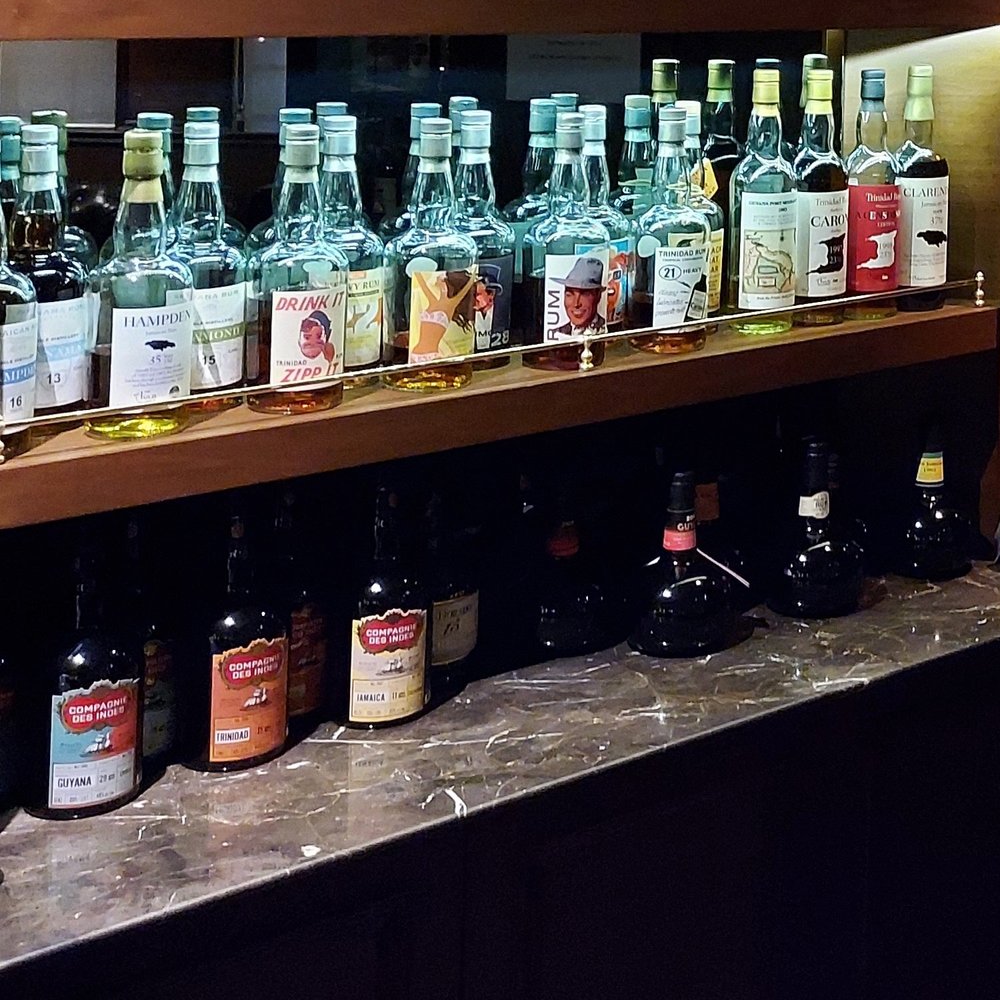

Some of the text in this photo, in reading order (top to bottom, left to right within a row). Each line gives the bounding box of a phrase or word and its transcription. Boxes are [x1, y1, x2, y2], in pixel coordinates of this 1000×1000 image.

[664, 267, 675, 278] 21
[275, 291, 344, 311] DRINK IT
[124, 310, 191, 328] HAMPDEN
[547, 290, 560, 341] RUM
[203, 355, 216, 365] 15
[47, 373, 61, 385] 13
[280, 366, 322, 383] ZIPP
[10, 395, 22, 408] 16
[366, 623, 417, 638] COMPAGNIE
[369, 632, 414, 645] DES INDES
[229, 653, 280, 672] COMPAGNIE
[232, 663, 278, 680] DES INDES
[357, 692, 386, 702] JAMAICA
[68, 696, 128, 715] COMPAGNIE
[72, 706, 125, 724] DES INDES
[216, 730, 249, 742] TRINIDAD
[57, 776, 92, 788] GUYANA
